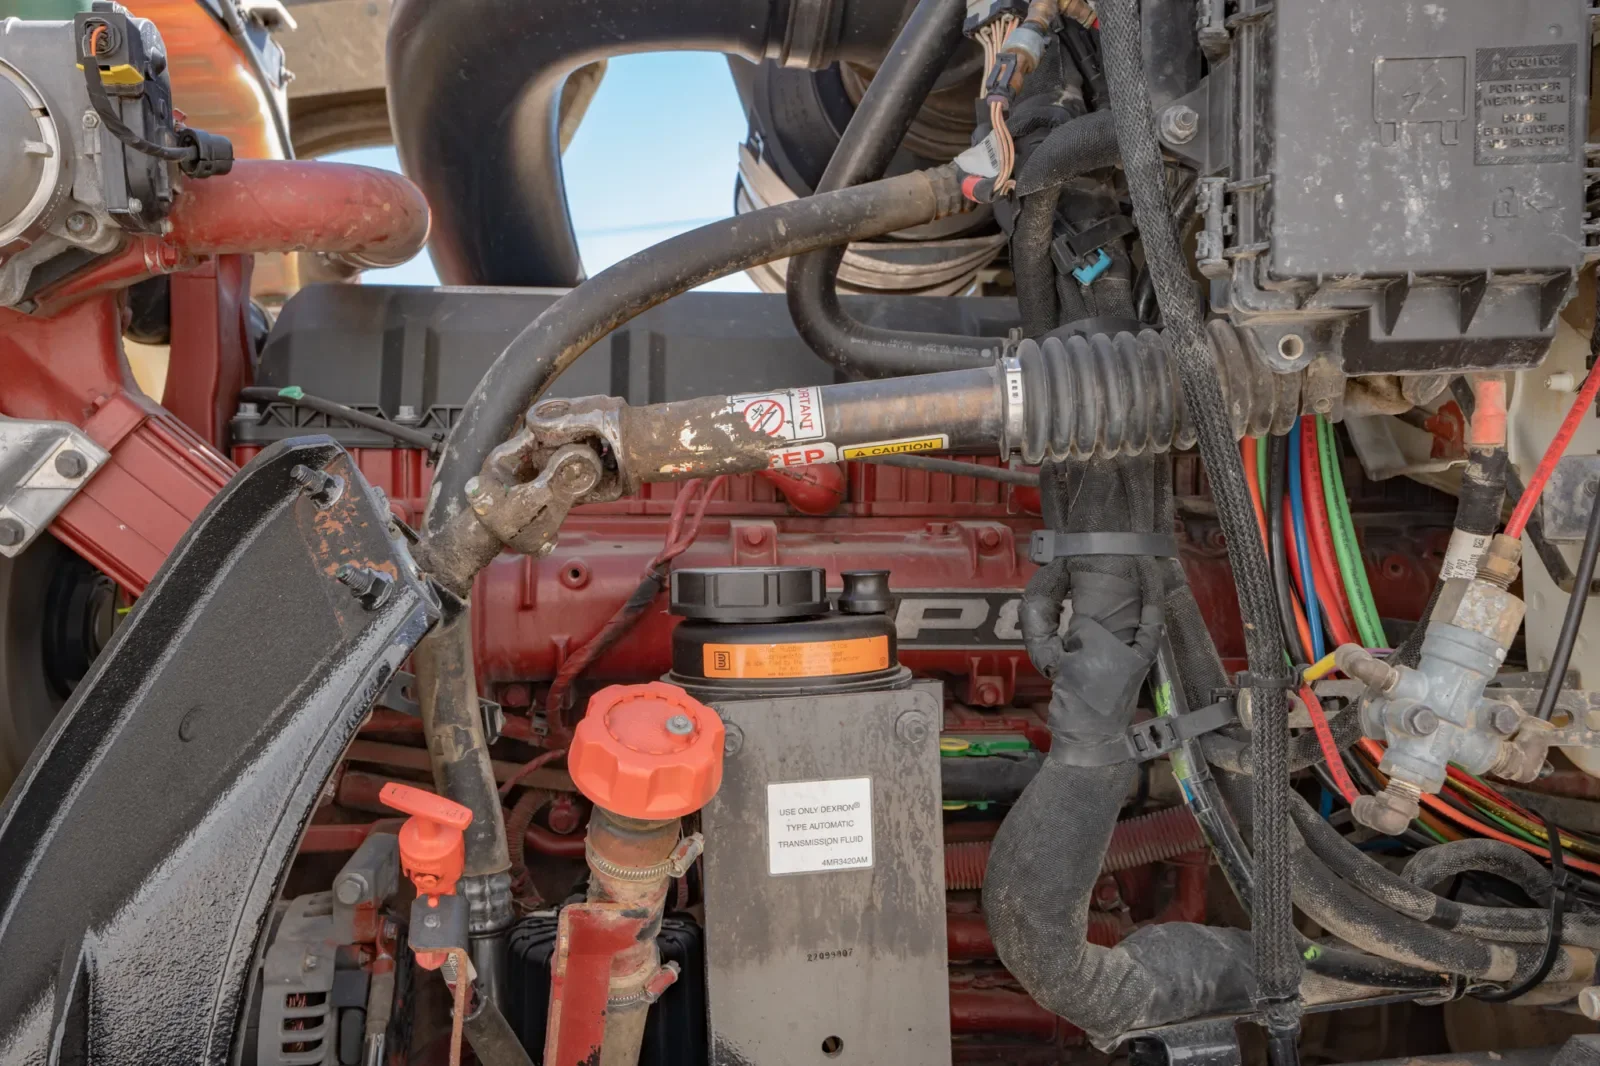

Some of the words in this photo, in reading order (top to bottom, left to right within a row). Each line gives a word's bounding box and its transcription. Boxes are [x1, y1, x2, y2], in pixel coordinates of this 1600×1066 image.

[871, 442, 933, 455] CAUTION
[779, 808, 796, 816] USE
[798, 806, 819, 815] ONLY
[786, 823, 808, 832] TYPE
[809, 820, 855, 830] AUTOMATIC
[778, 837, 839, 848] TRANSMISSION
[840, 835, 864, 844] FLUID
[822, 856, 868, 866] 4MR3420AM
